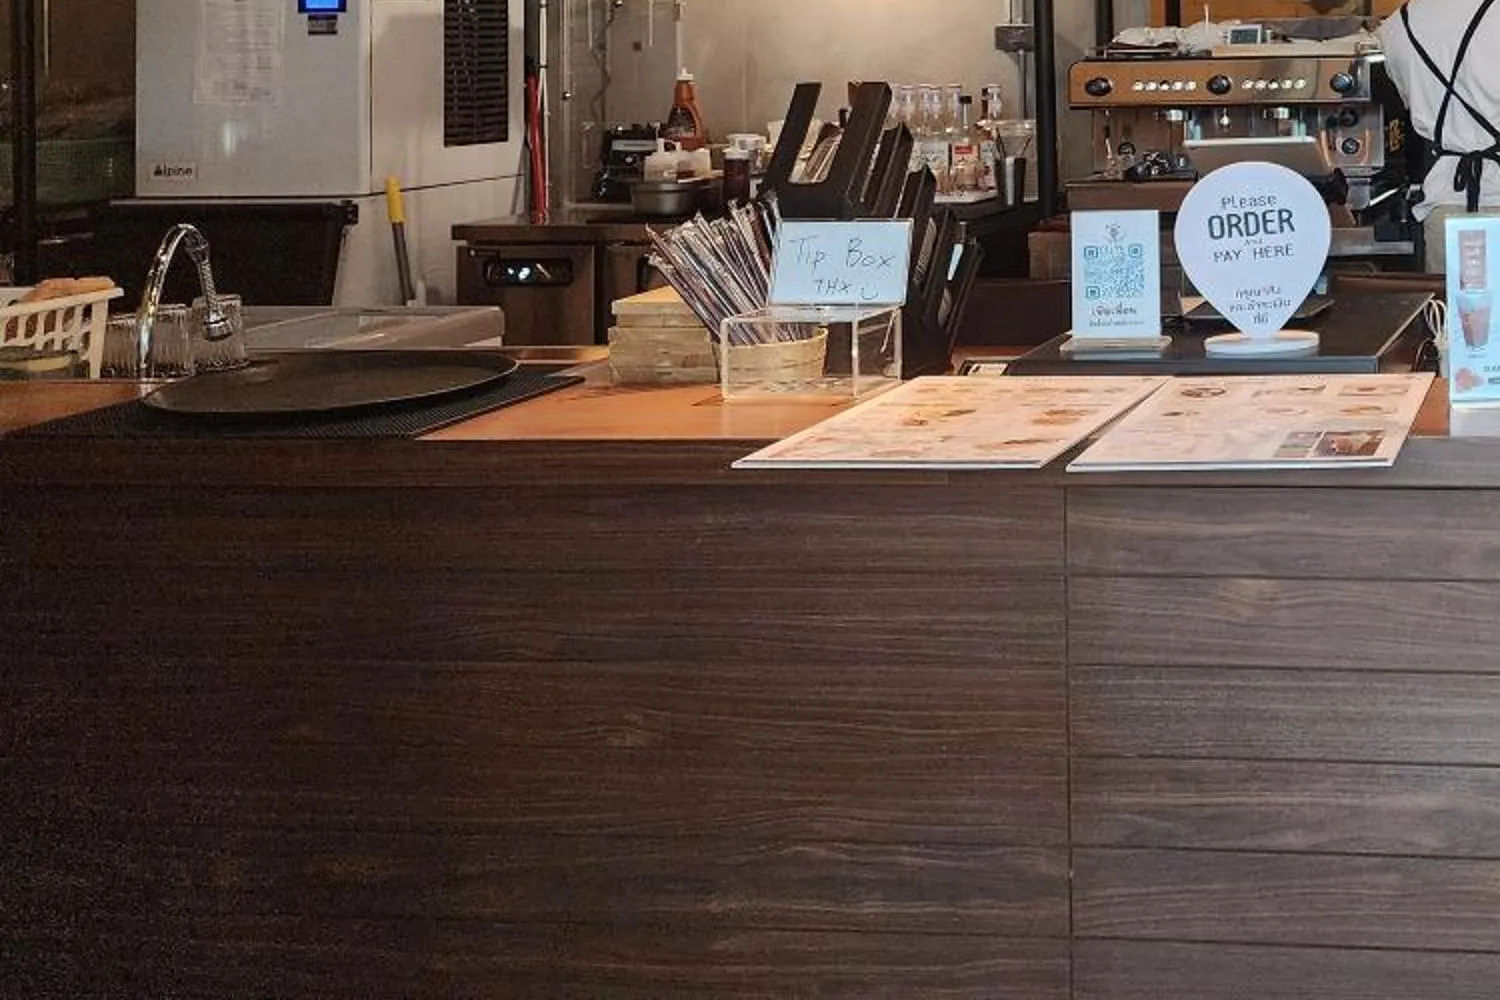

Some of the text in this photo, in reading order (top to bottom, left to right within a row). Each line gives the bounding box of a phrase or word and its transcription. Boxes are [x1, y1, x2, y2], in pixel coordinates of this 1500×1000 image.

[1208, 207, 1296, 240] ORDER
[845, 236, 897, 269] Box
[1213, 243, 1295, 263] PAY HERE
